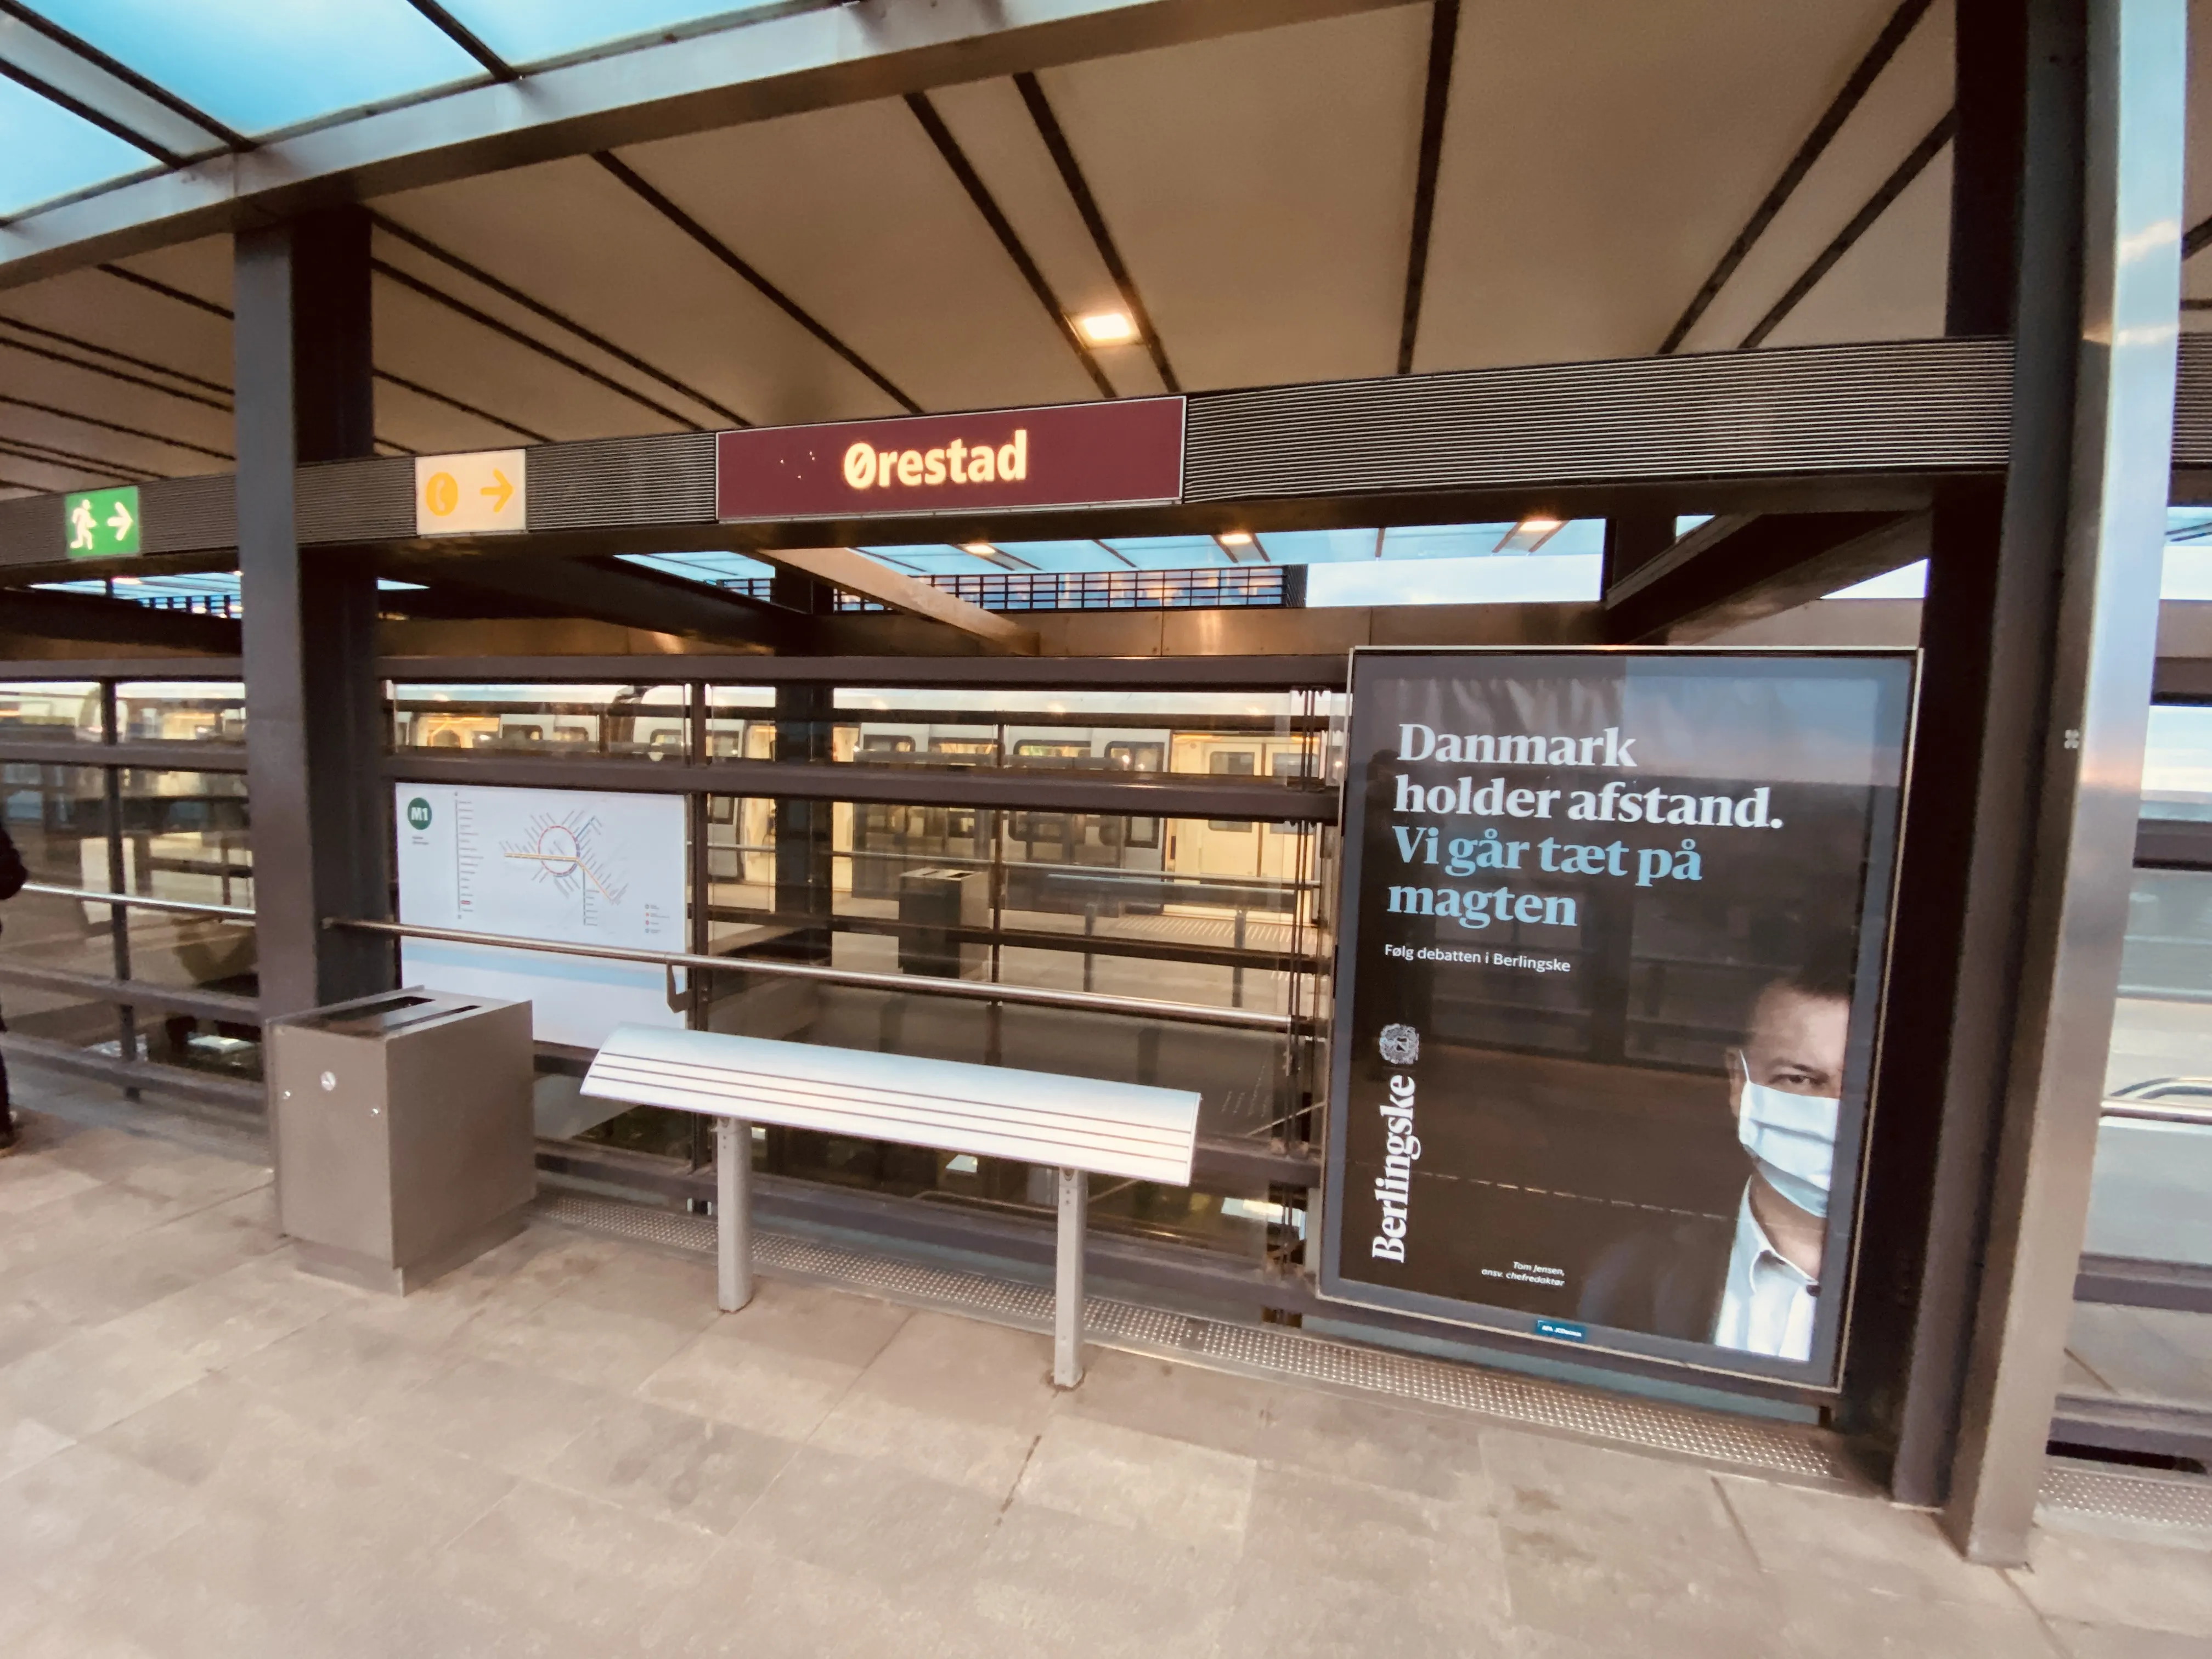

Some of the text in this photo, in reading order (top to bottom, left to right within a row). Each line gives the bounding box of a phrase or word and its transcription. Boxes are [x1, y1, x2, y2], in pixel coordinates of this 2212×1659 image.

[844, 429, 1027, 488] Ørestad
[1397, 724, 1638, 767] Danmark
[411, 807, 428, 821] M1
[1393, 774, 1784, 829] holder afstand.
[1392, 825, 1703, 888] Vi går tæt på
[1387, 885, 1577, 929] magten
[1385, 944, 1571, 973] Følg debatten i Berlingske
[1372, 1075, 1421, 1263] Berlingske
[1481, 1269, 1565, 1286] ansv. chefredaktør
[1513, 1261, 1565, 1277] Tom Jensen,
